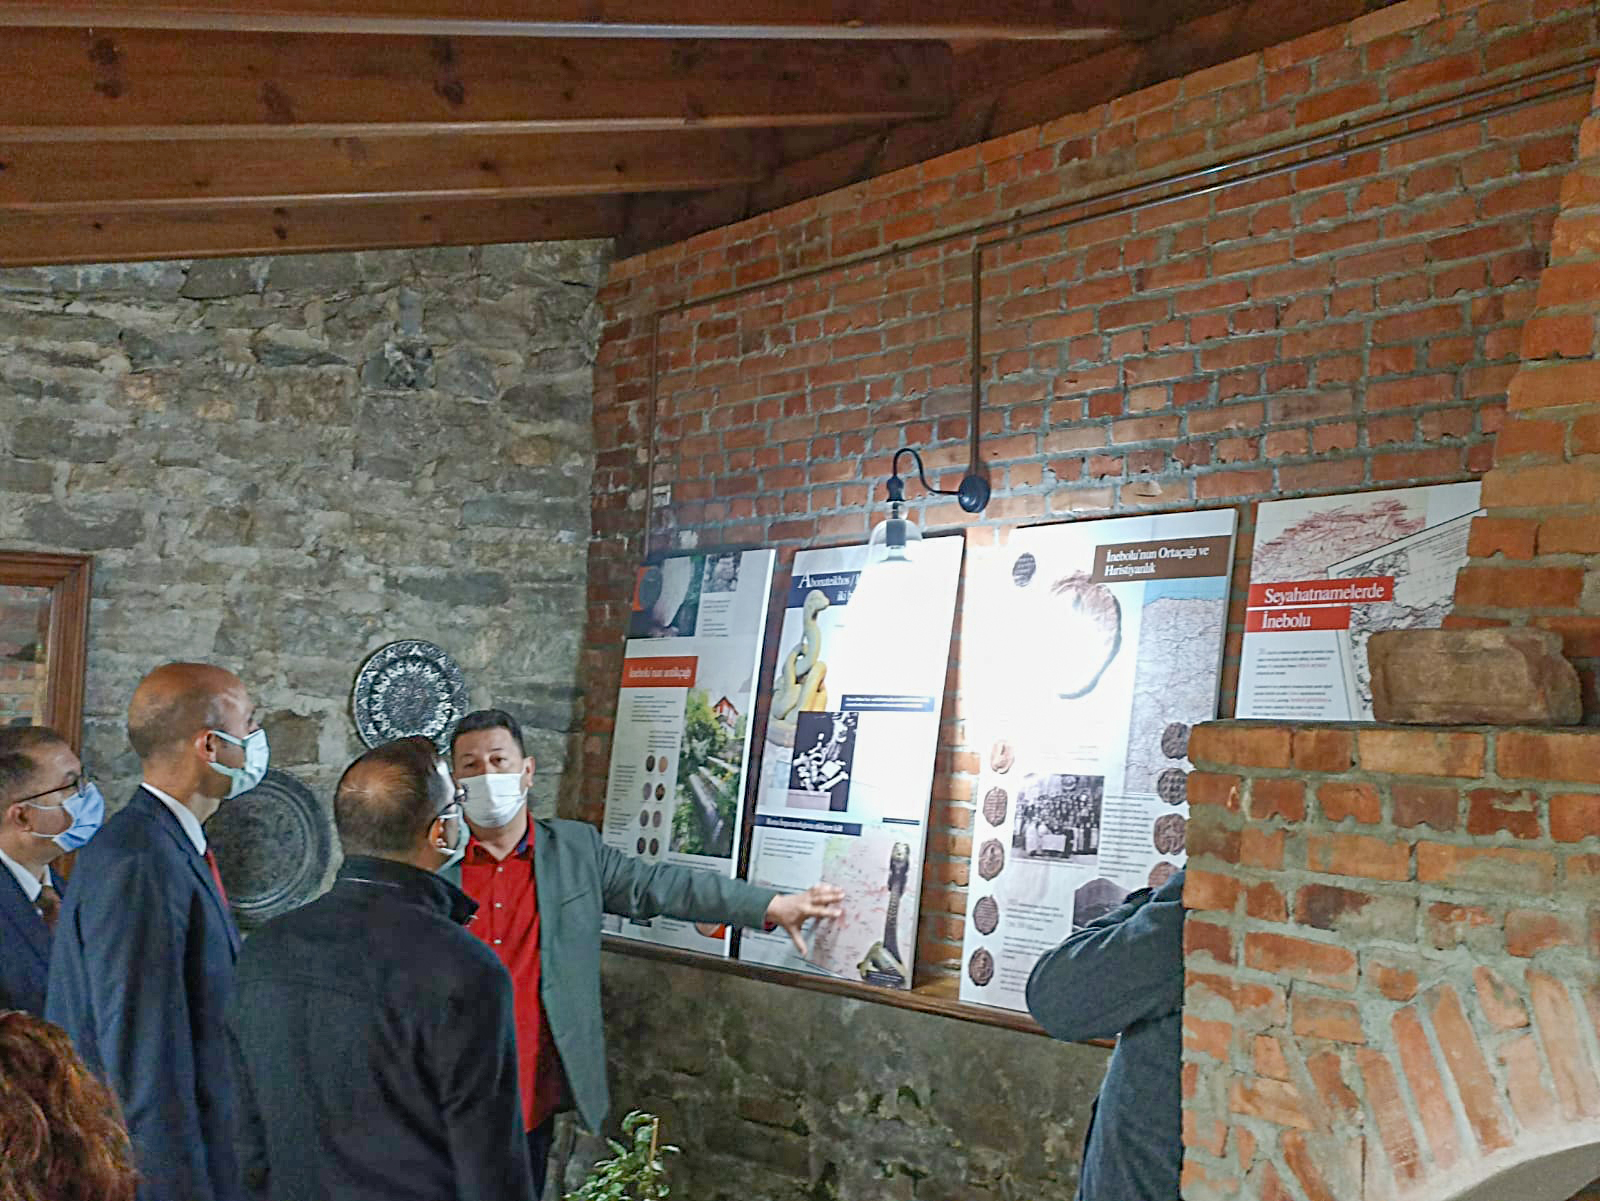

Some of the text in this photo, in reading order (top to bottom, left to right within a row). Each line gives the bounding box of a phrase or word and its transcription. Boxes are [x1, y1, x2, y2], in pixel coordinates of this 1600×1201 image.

[1158, 545, 1198, 560] Ortaçağı
[1199, 546, 1210, 556] ve
[1264, 582, 1385, 606] Seyahatnamelerde
[1262, 611, 1312, 629] İnebolu
